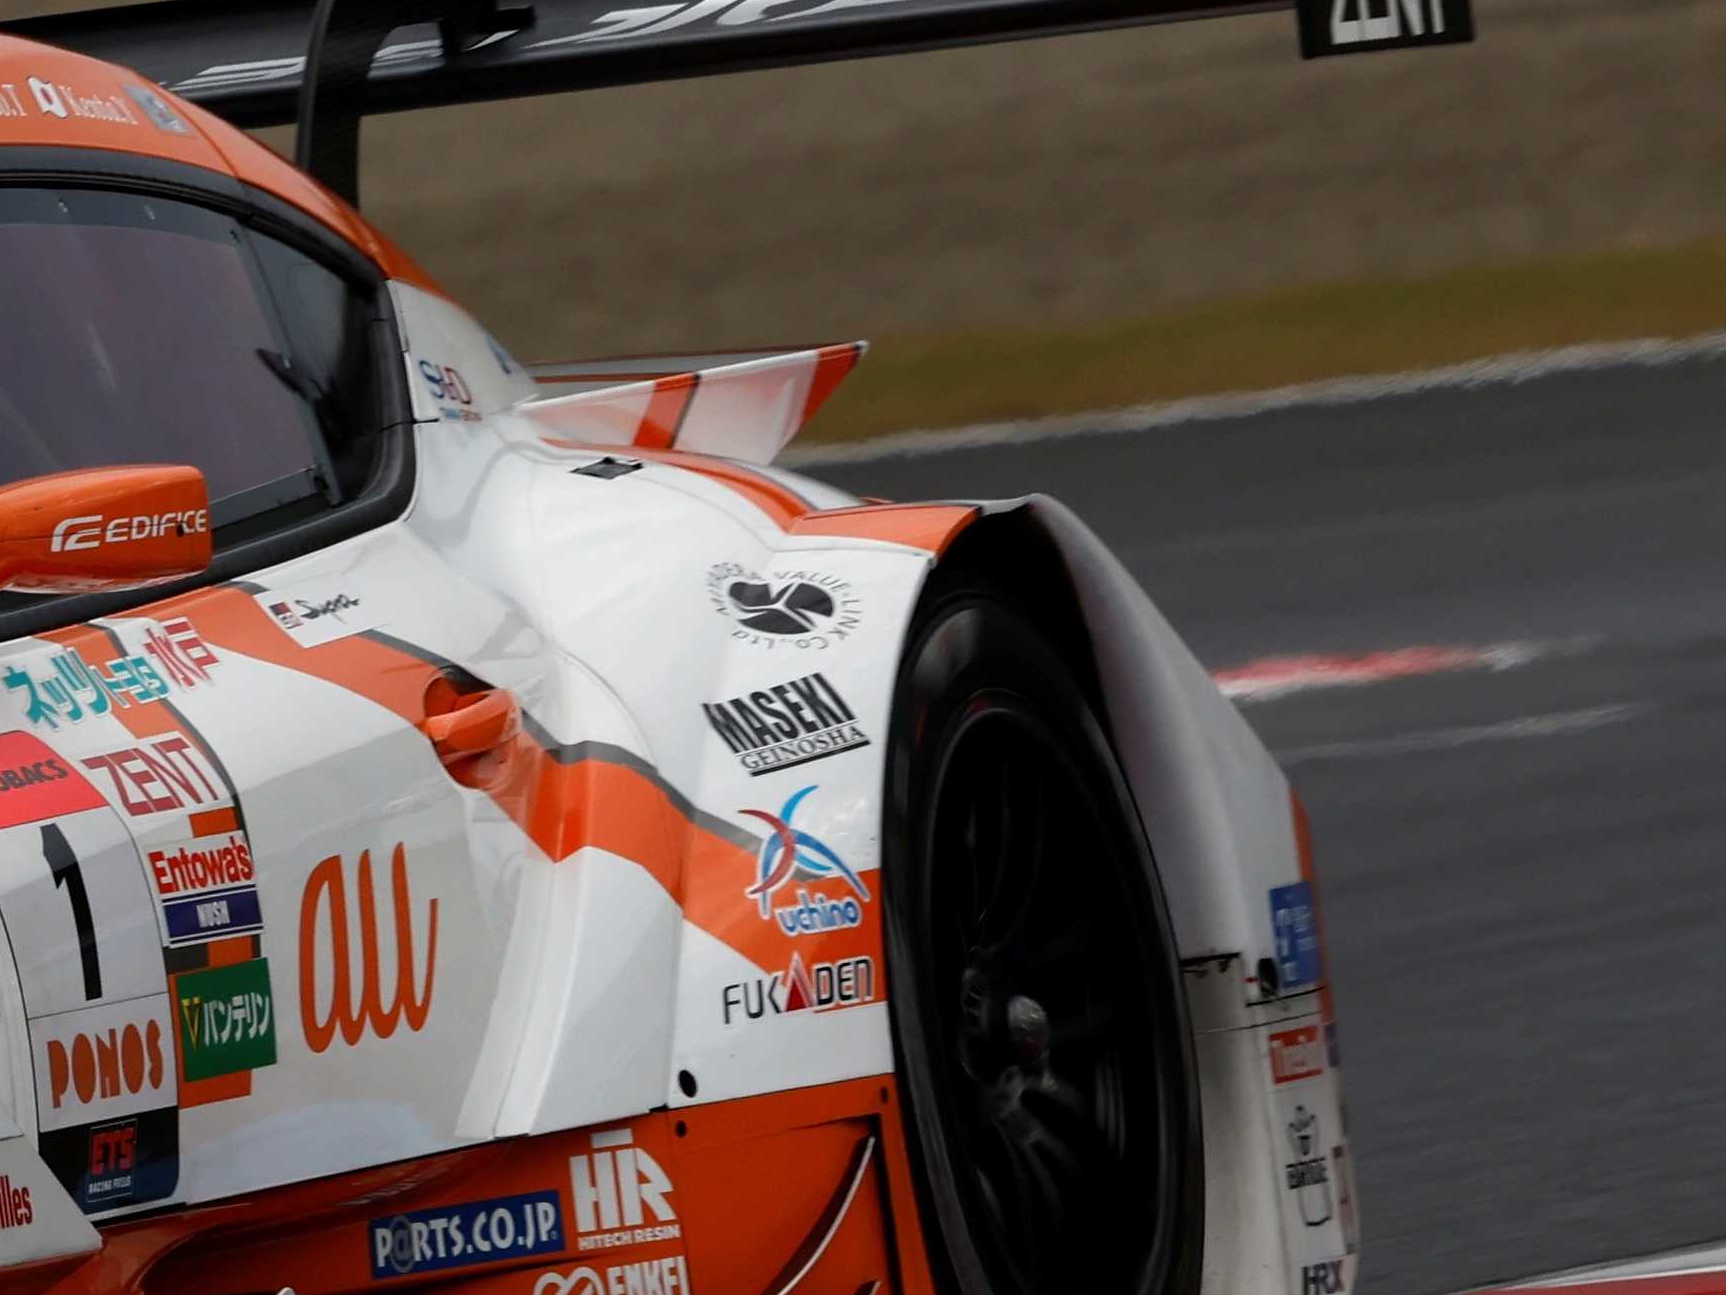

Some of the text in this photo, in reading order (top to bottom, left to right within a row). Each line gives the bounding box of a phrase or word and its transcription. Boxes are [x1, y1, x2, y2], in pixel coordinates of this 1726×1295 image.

[104, 508, 207, 544] EDIFICE
[3, 620, 220, 730] ネッツトヨタ 水戸
[701, 672, 857, 755] MASEKI
[741, 723, 868, 773] GEINOSHA
[80, 736, 221, 816] ZENT
[147, 835, 255, 895] Entowa's
[40, 822, 103, 1002] 1
[299, 841, 439, 1053] au
[777, 890, 861, 935] uchino
[203, 991, 271, 1047] バンテリン
[723, 953, 873, 1025] FUKADEN
[47, 1019, 164, 1109] PONOS
[578, 1224, 681, 1251] HITECH RESIN
